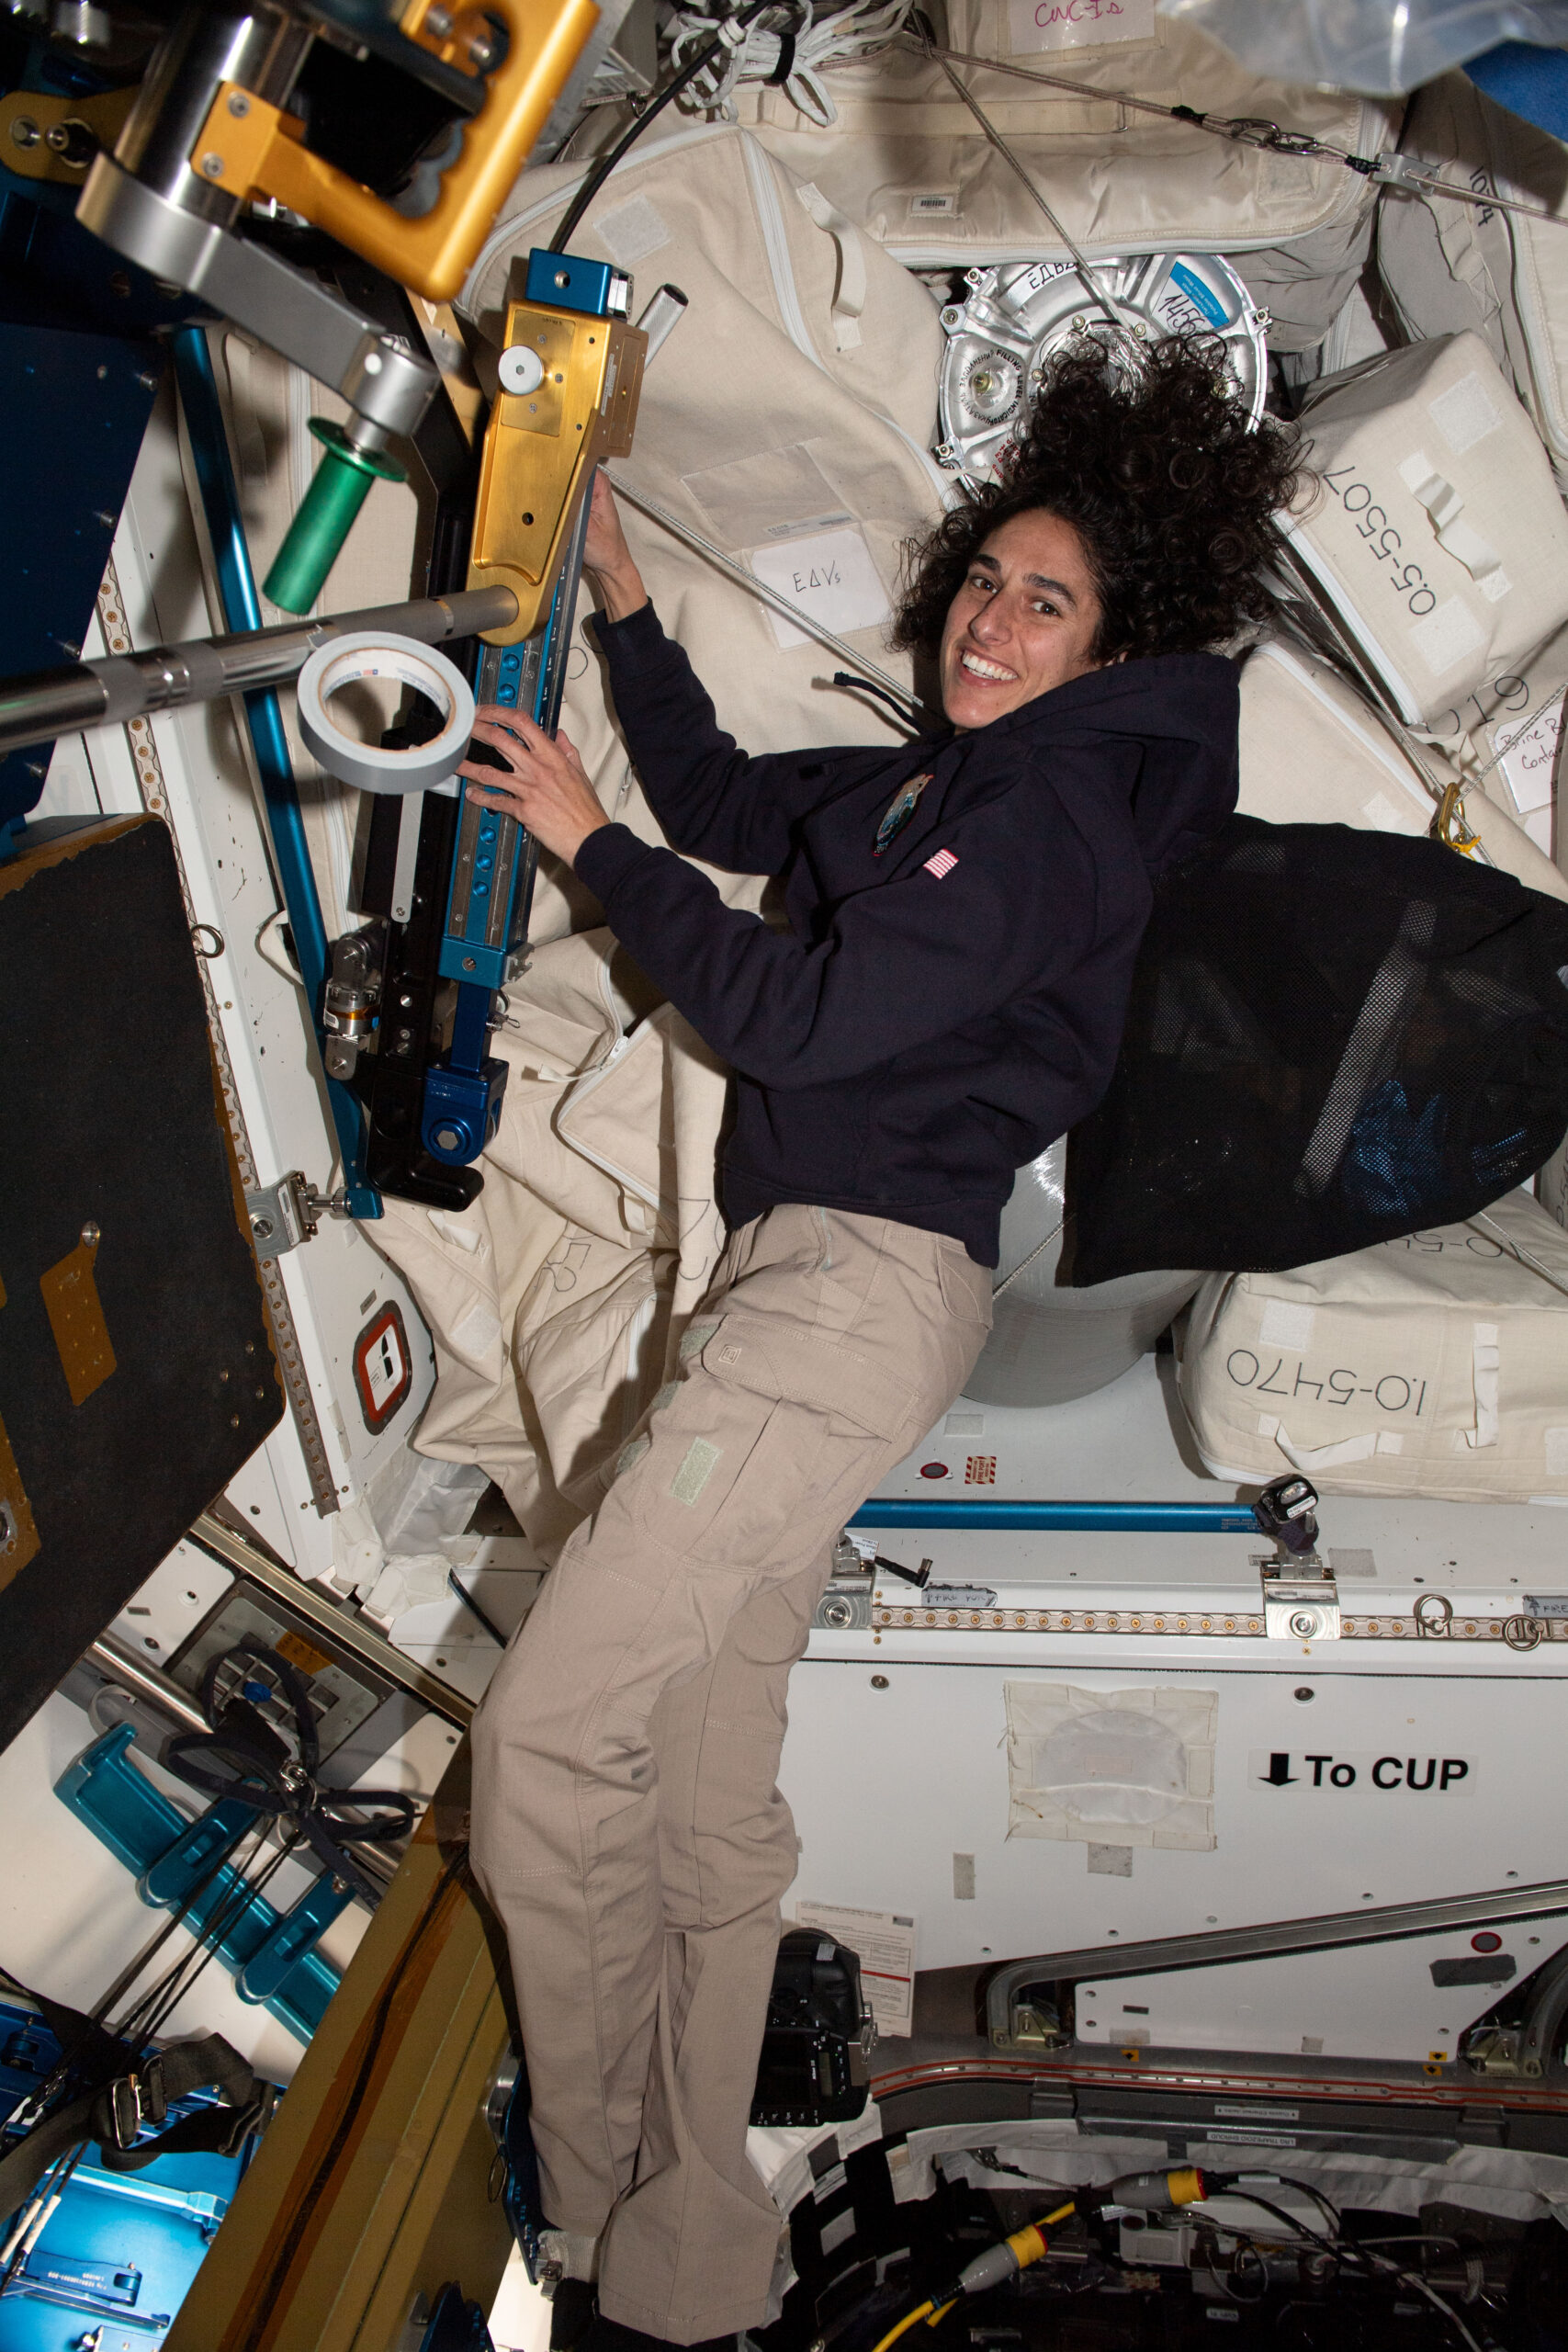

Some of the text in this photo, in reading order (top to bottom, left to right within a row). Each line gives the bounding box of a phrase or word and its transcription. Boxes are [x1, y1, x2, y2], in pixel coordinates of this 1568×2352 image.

[997, 348, 1021, 371] FILLING
[1015, 374, 1023, 399] LEVEL
[1323, 466, 1436, 615] 0.5-5507
[1226, 1349, 1427, 1416] 1.0-5470
[1304, 1755, 1469, 1791] To CUP
